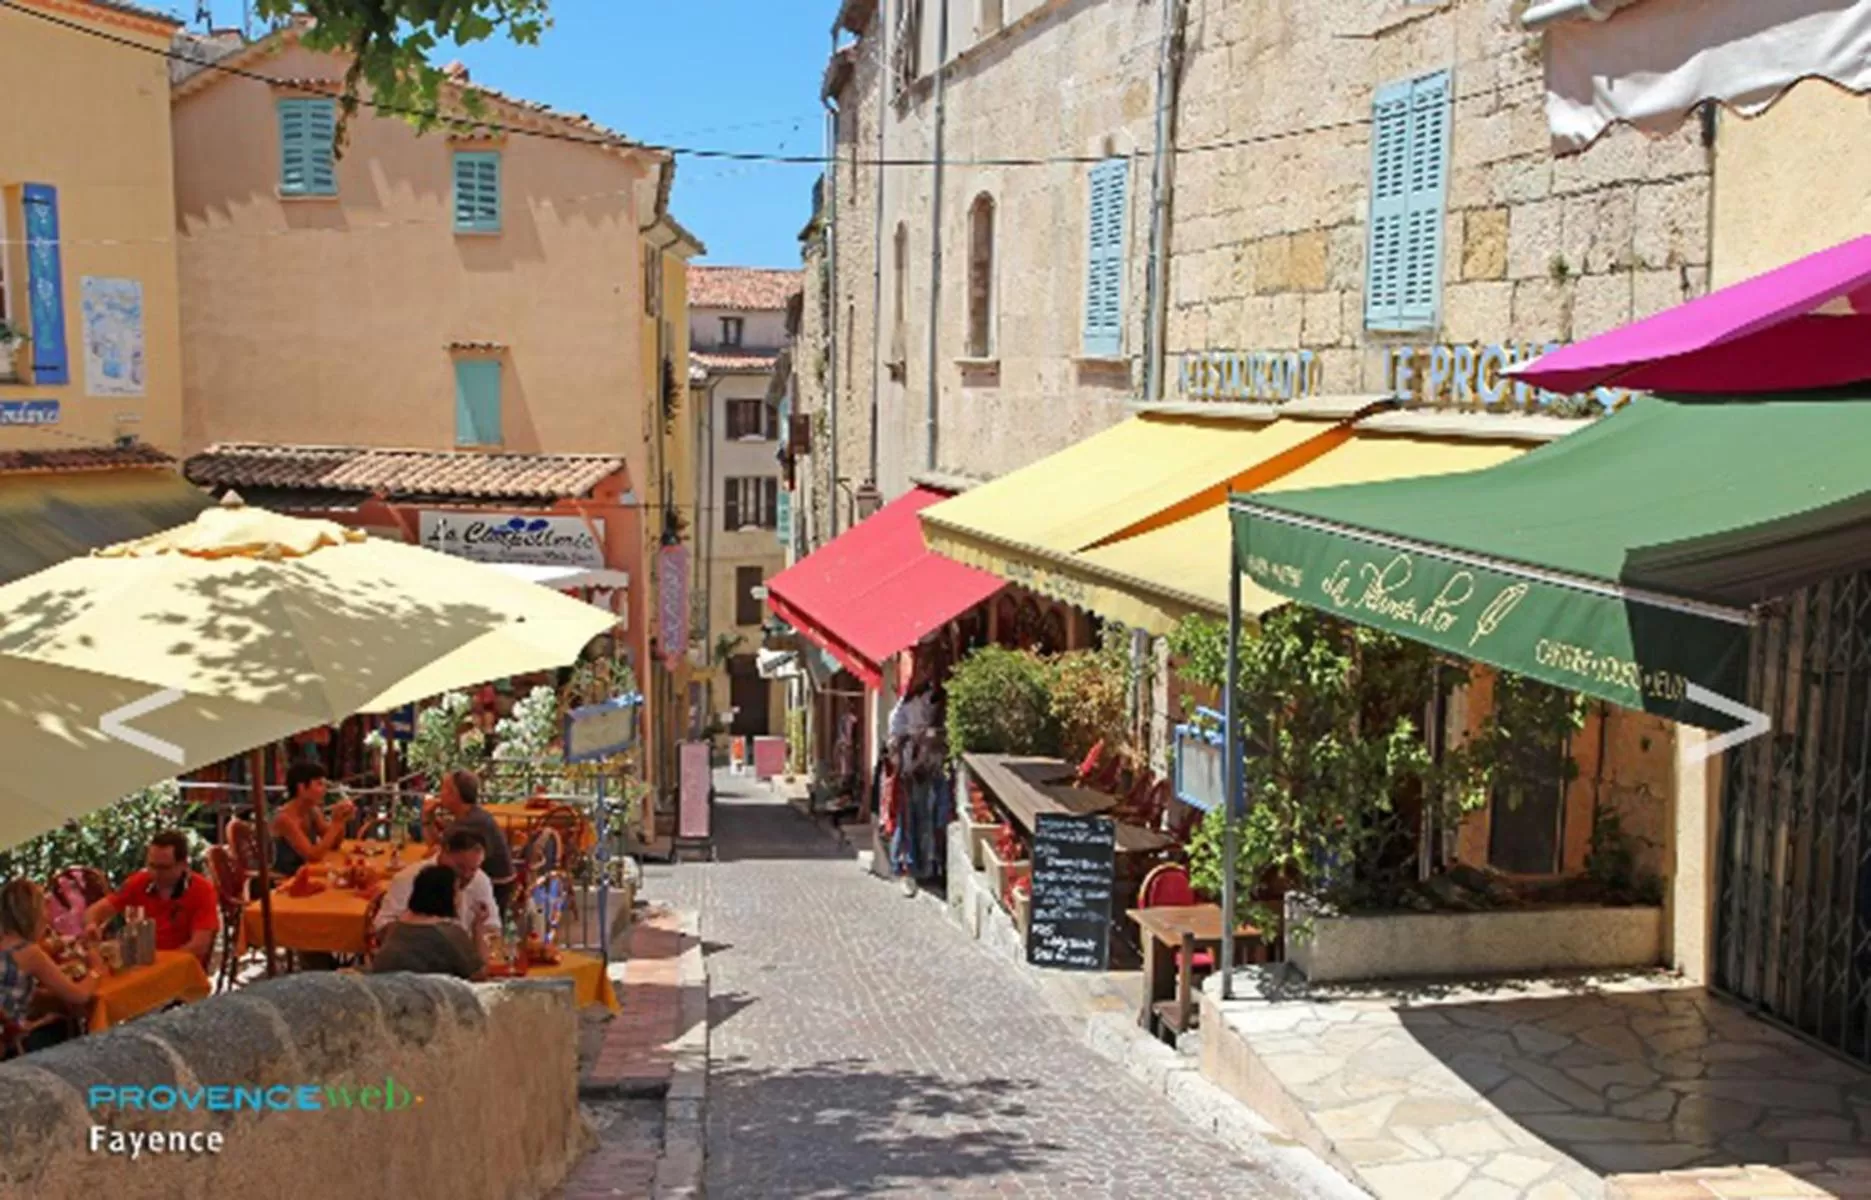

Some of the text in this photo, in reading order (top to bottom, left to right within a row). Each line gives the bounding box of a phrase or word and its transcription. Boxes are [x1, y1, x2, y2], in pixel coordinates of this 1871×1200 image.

[1179, 350, 1322, 401] RESTAURANT
[1384, 345, 1416, 399] LE
[428, 518, 458, 543] La
[1321, 559, 1351, 608] La
